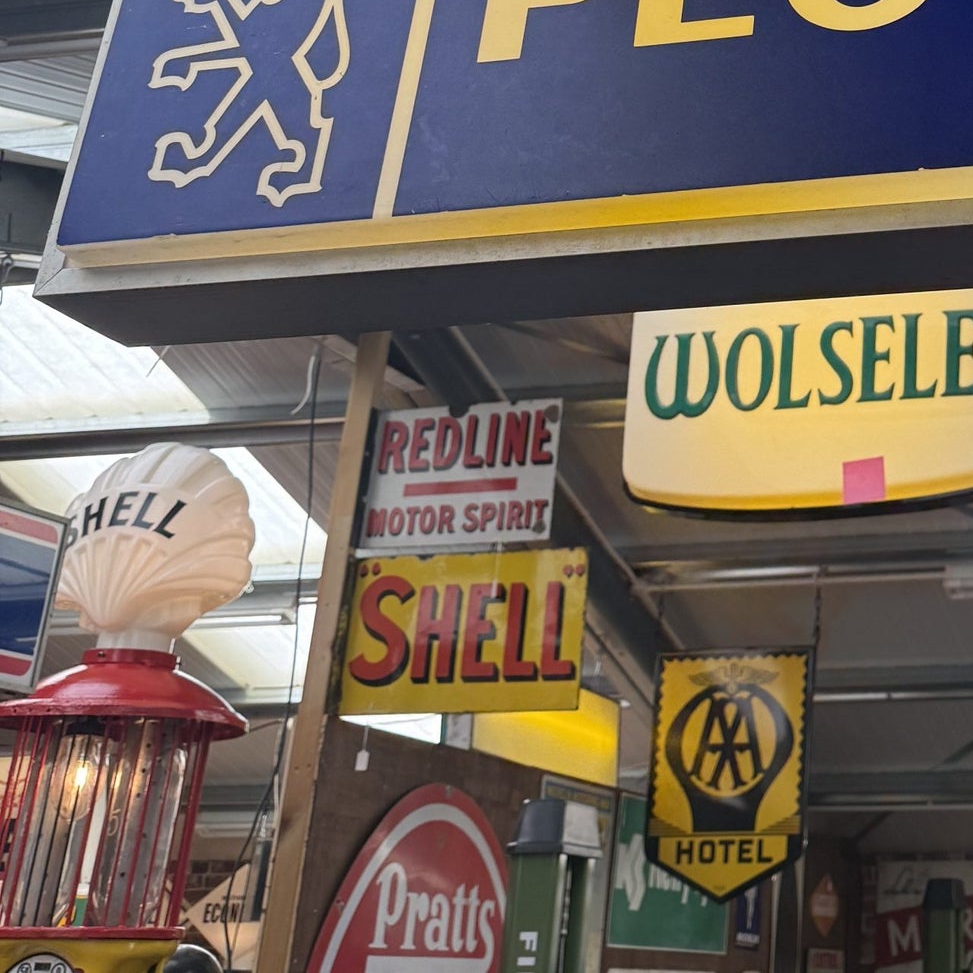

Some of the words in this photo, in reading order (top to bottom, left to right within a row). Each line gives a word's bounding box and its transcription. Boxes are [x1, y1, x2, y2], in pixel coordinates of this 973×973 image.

[378, 409, 554, 475] REDLINE
[66, 490, 188, 548] SHELL
[366, 504, 456, 538] MOTOR
[461, 498, 550, 534] SPIRIT
[674, 838, 774, 865] HOTEL
[368, 861, 496, 955] Pratts
